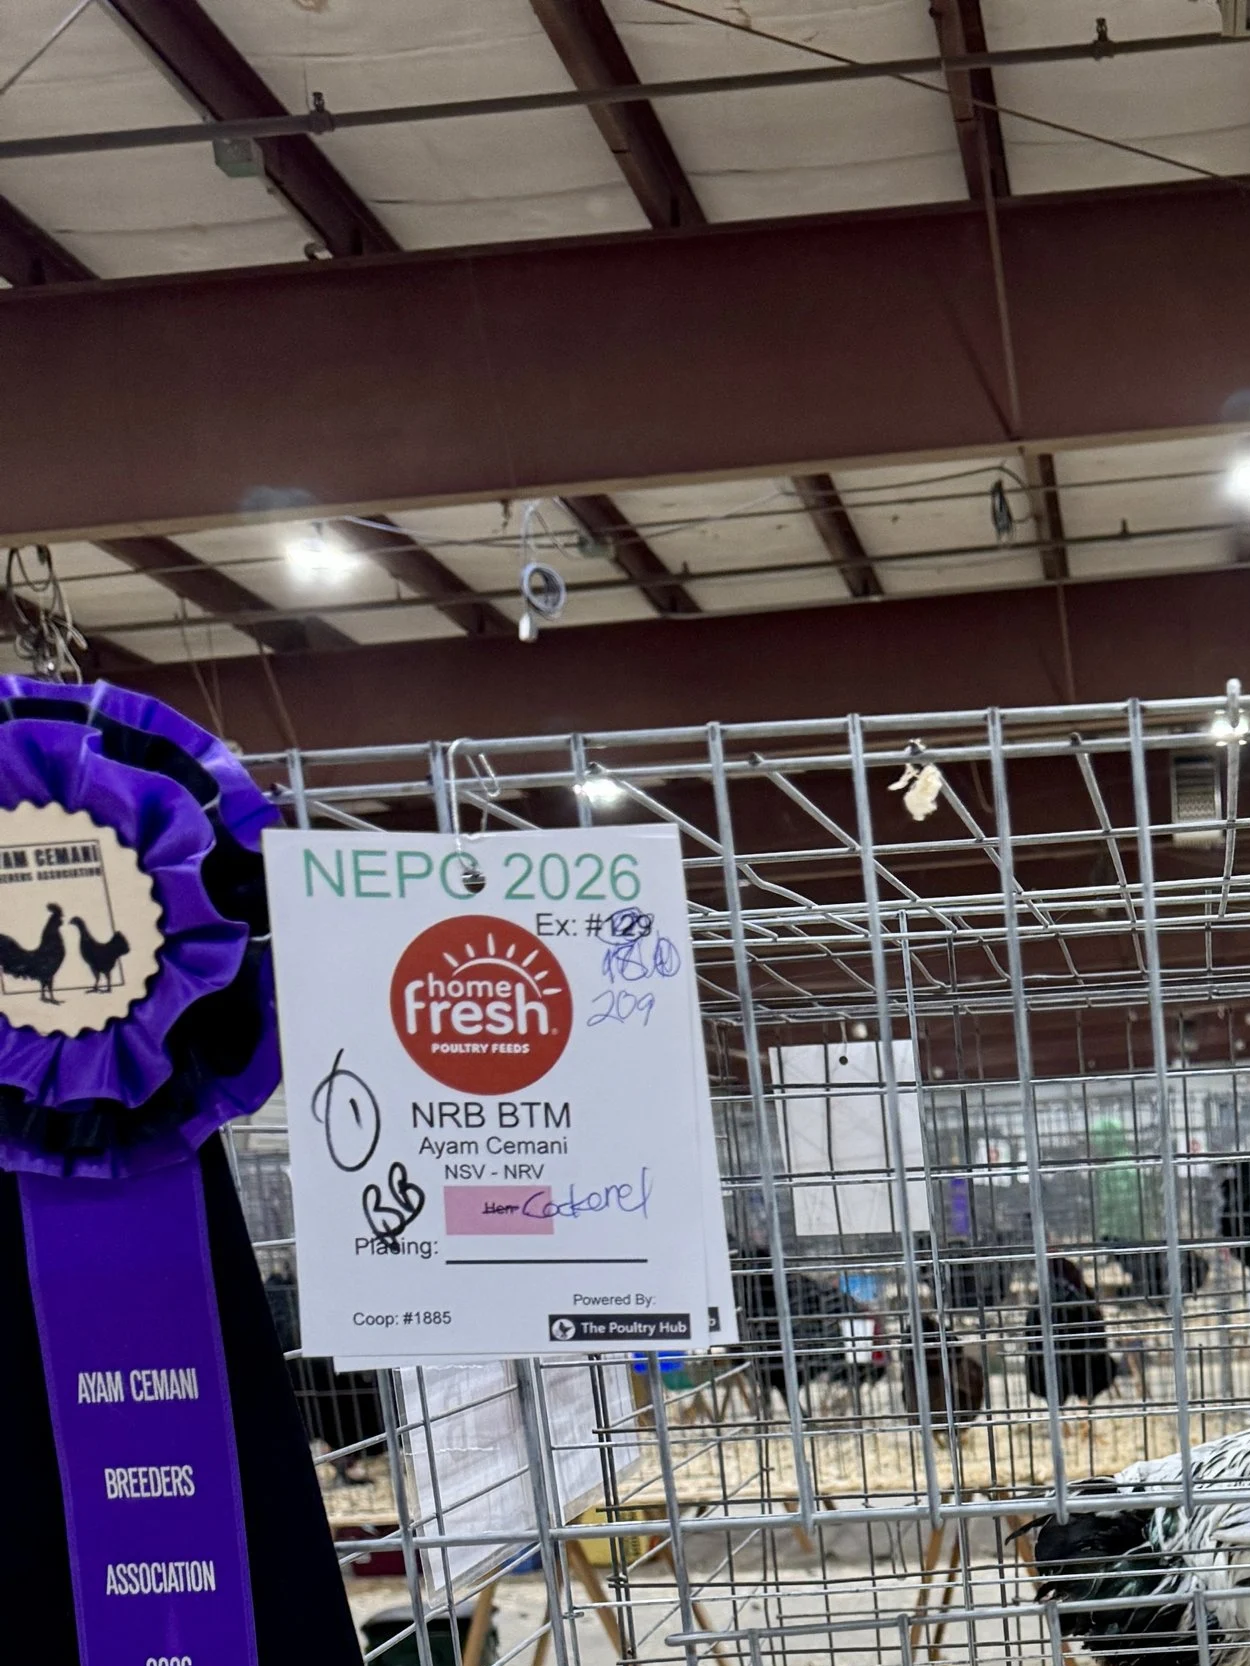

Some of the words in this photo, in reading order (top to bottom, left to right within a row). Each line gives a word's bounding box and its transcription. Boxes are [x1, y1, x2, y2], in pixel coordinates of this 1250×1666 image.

[0, 851, 28, 869] AM
[35, 845, 98, 866] CEMANI
[504, 852, 641, 900] 2026
[536, 913, 577, 936] Ex:
[428, 972, 512, 997] home
[405, 980, 549, 1035] fresh
[586, 990, 655, 1027] 209
[431, 1043, 489, 1054] POULTRY
[492, 1043, 530, 1054] FEEDS
[412, 1102, 486, 1129] NRB
[500, 1102, 571, 1129] BTM
[419, 1136, 479, 1159] Ayam
[486, 1136, 569, 1155] Cemani
[445, 1164, 486, 1180] NSV
[504, 1164, 545, 1180] NRV
[573, 1293, 632, 1307] Powered
[636, 1293, 656, 1308] By:
[353, 1312, 399, 1328] Coop:
[403, 1311, 452, 1326] #1885
[581, 1322, 605, 1335] The
[609, 1321, 656, 1338] Poultry
[659, 1320, 688, 1334] Hub
[77, 1371, 125, 1404] AYAM
[130, 1368, 199, 1402] CEMANI
[104, 1464, 195, 1499] BREEDERS
[106, 1560, 216, 1595] ASSOCIATION
